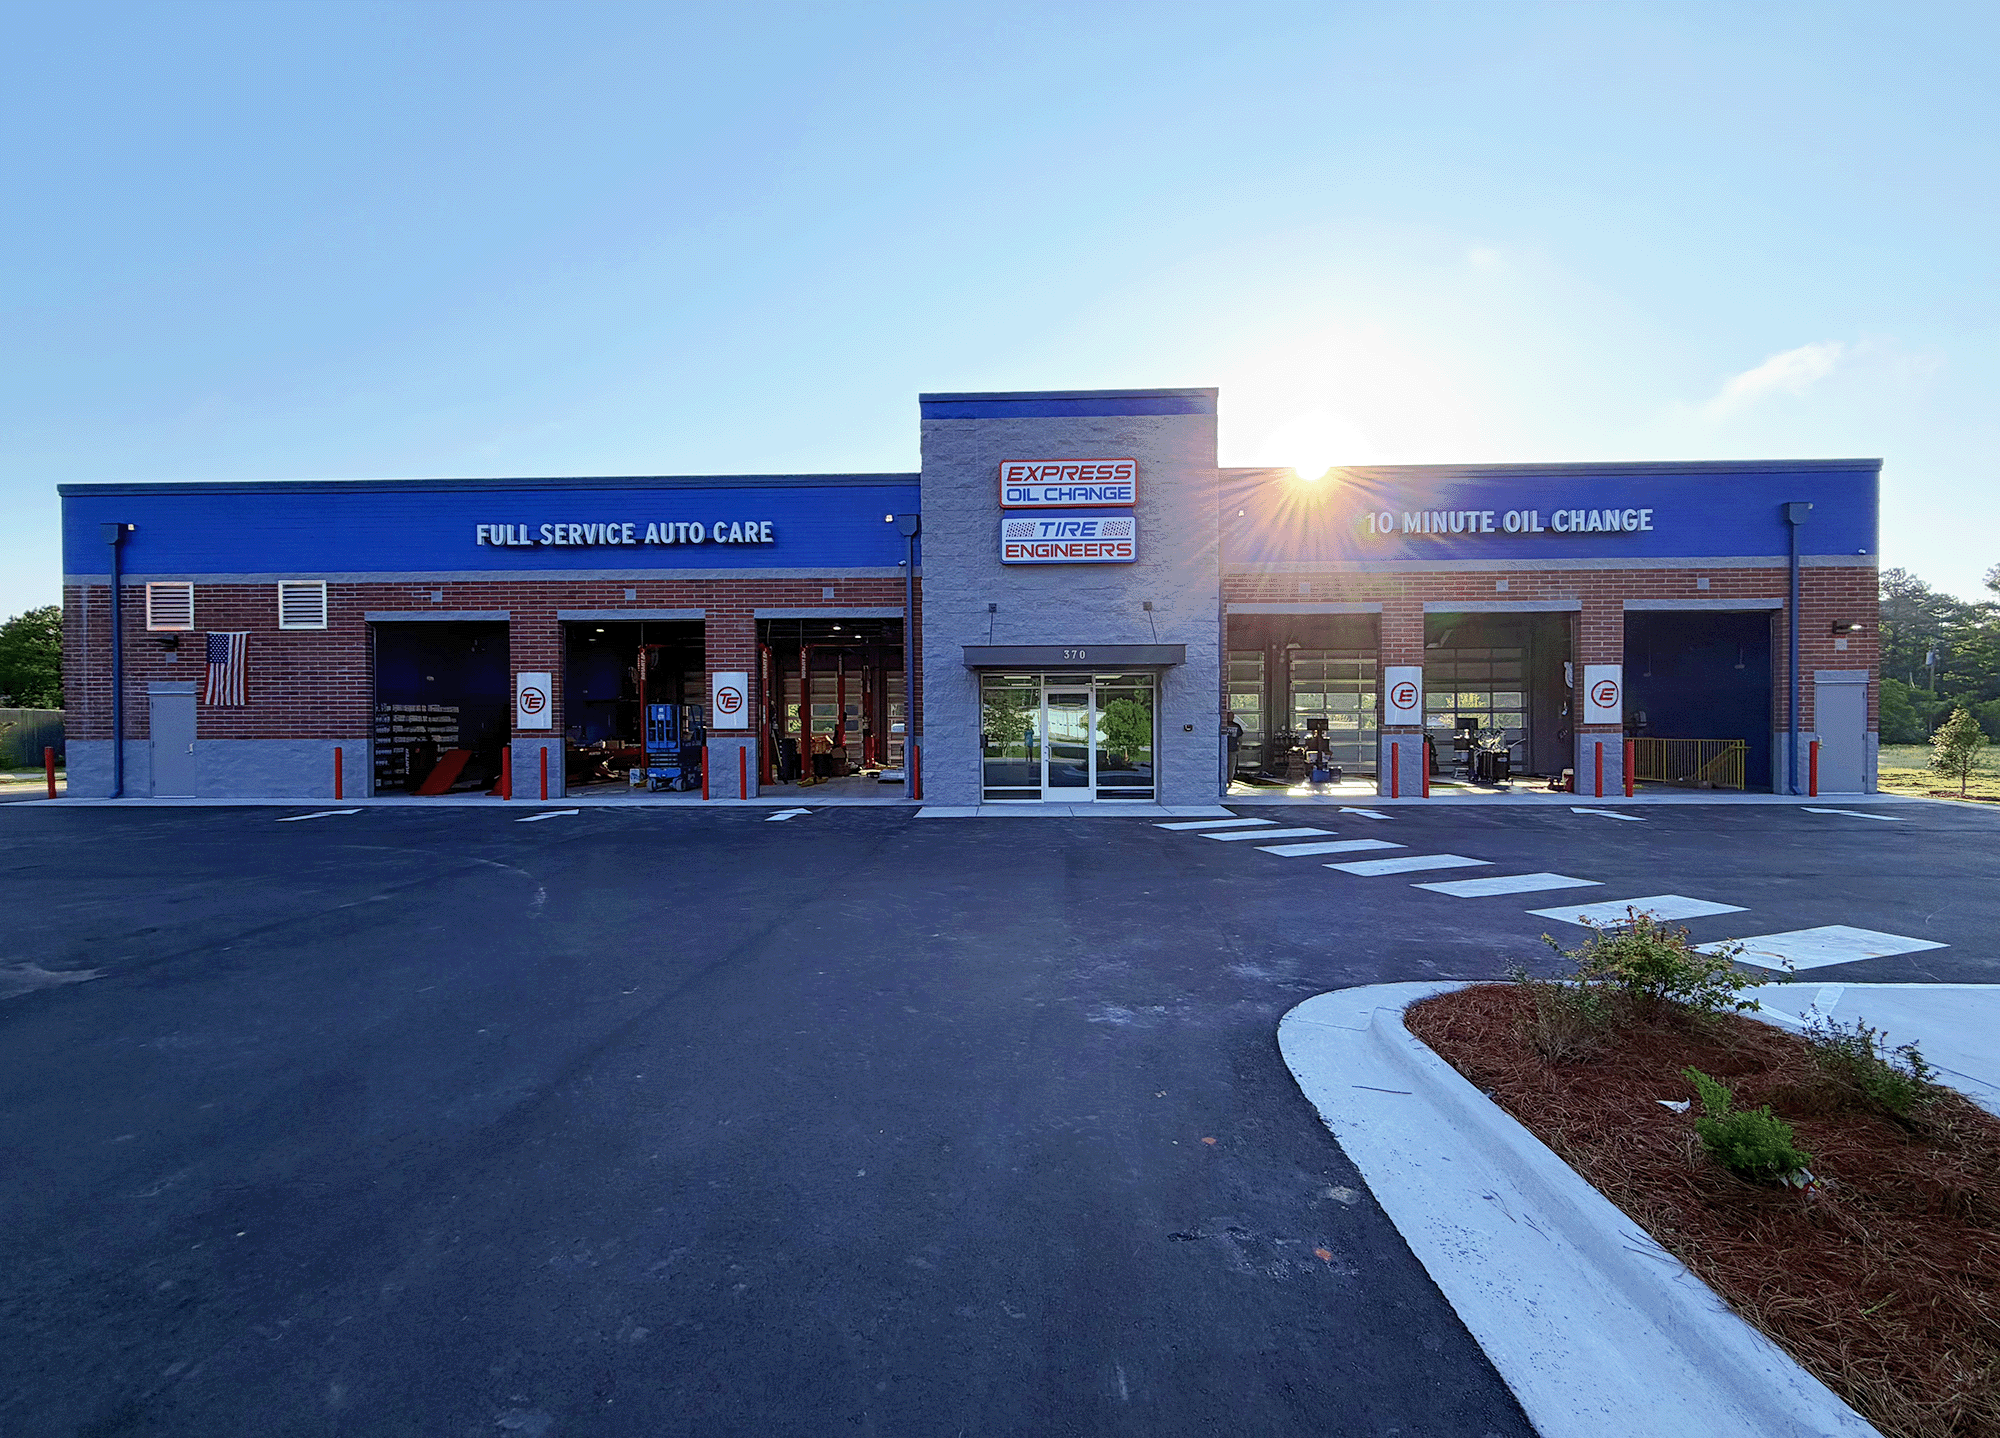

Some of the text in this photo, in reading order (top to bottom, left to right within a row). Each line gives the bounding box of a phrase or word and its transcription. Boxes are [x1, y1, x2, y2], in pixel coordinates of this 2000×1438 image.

[1006, 464, 1133, 482] EXPRESS
[1006, 486, 1132, 502] OIL CHANGE
[1039, 521, 1098, 537] TIRE
[1366, 508, 1654, 534] 10 MINUTE OIL CHANGE
[476, 520, 775, 546] FULL SERVICE AUTO CARE
[1005, 543, 1132, 558] ENGINEERS
[1063, 649, 1086, 660] 370
